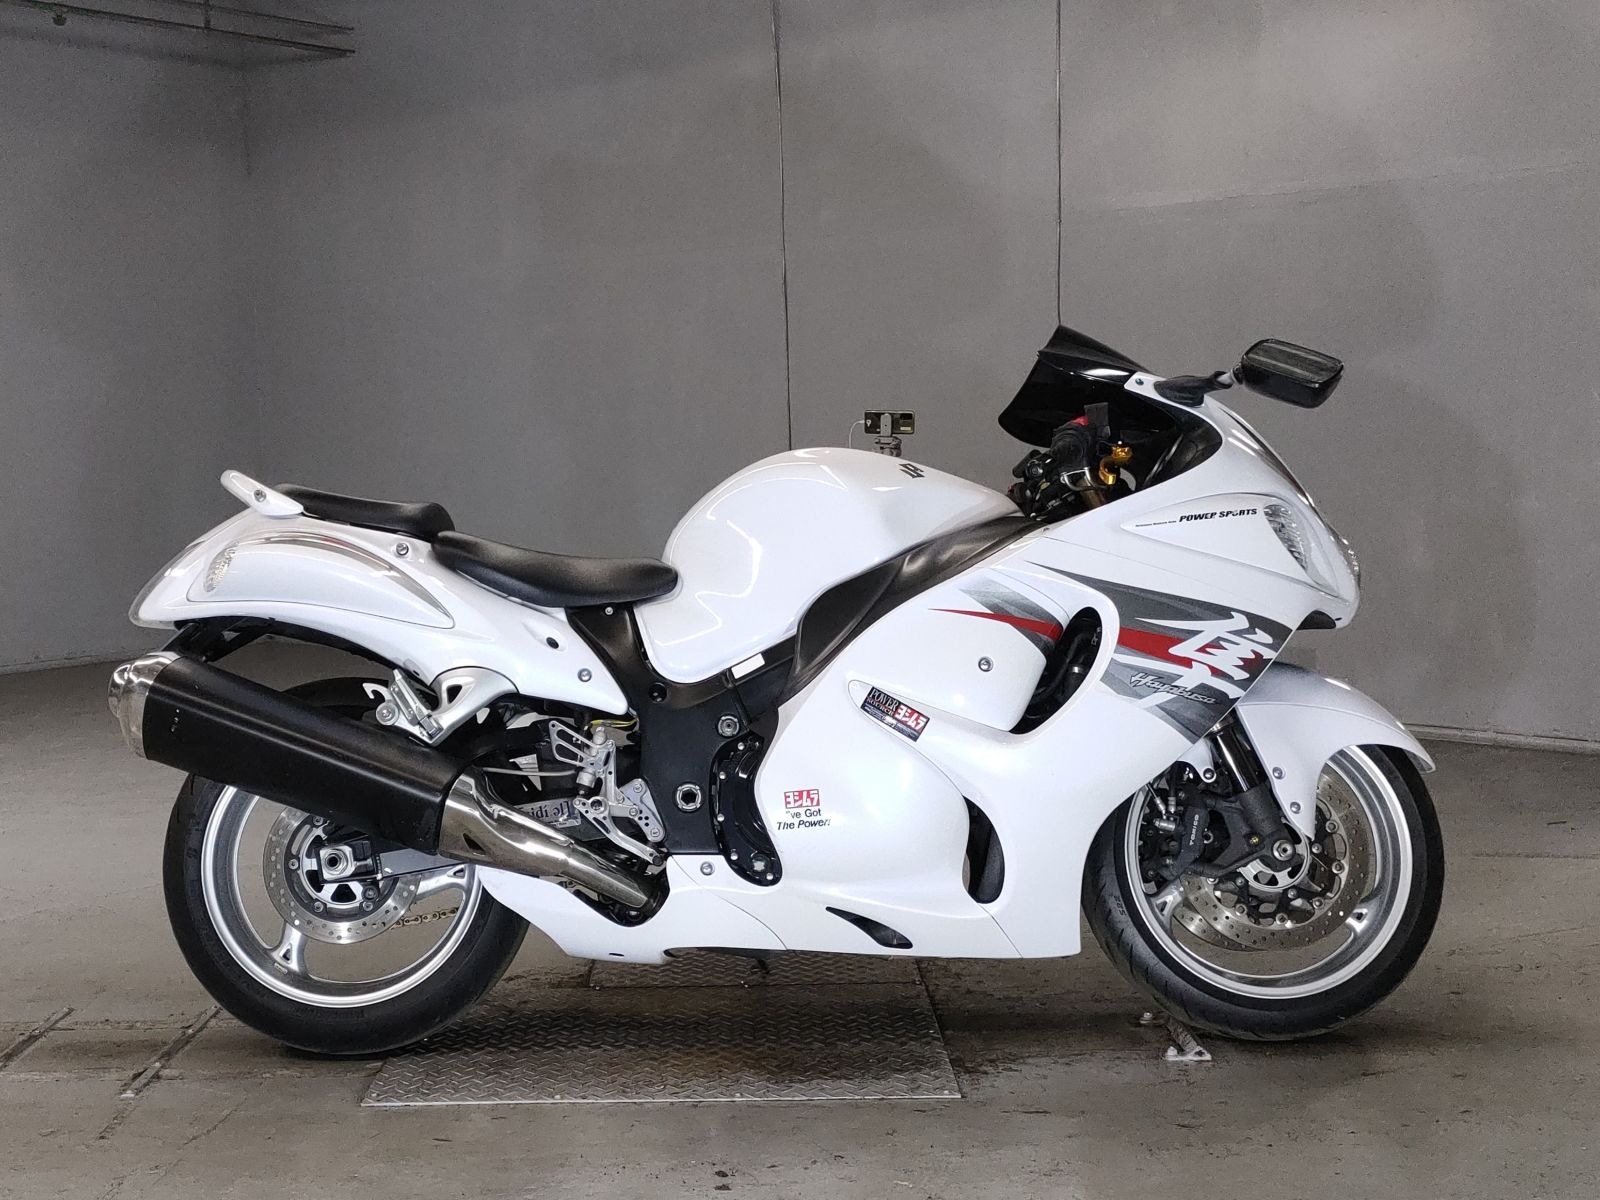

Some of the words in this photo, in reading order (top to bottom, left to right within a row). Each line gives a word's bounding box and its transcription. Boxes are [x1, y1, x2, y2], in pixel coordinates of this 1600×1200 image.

[1218, 508, 1257, 518] SPORTS
[1130, 672, 1218, 704] Hayabusa
[869, 688, 899, 712] POWER
[894, 703, 928, 731] ヨシムラ
[785, 790, 819, 808] ヨシムラ
[804, 808, 821, 817] Got
[777, 821, 795, 830] The
[1189, 814, 1199, 846] TOKICO
